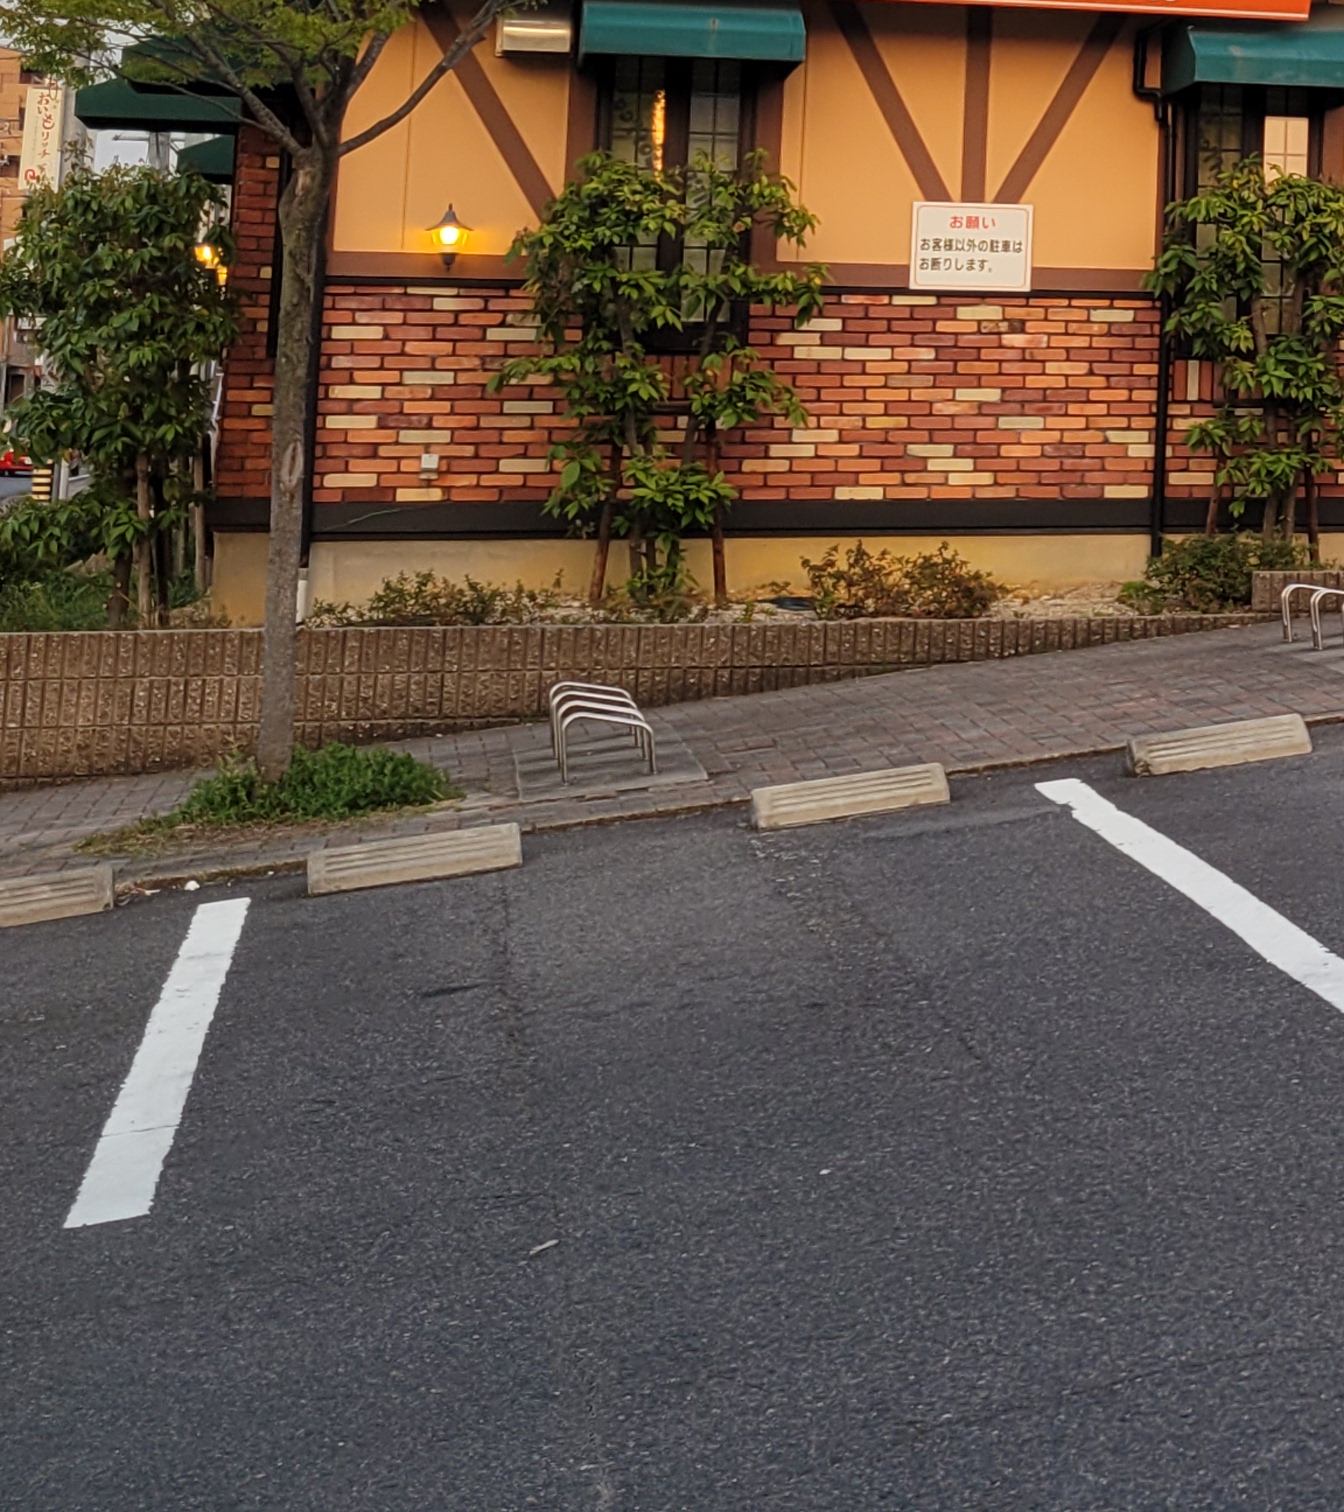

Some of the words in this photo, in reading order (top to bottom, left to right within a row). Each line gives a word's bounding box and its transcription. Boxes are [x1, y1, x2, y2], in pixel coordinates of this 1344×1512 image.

[949, 216, 996, 229] お願い
[920, 238, 1023, 253] お客様以外の駐車は
[919, 257, 992, 273] お断りします。
